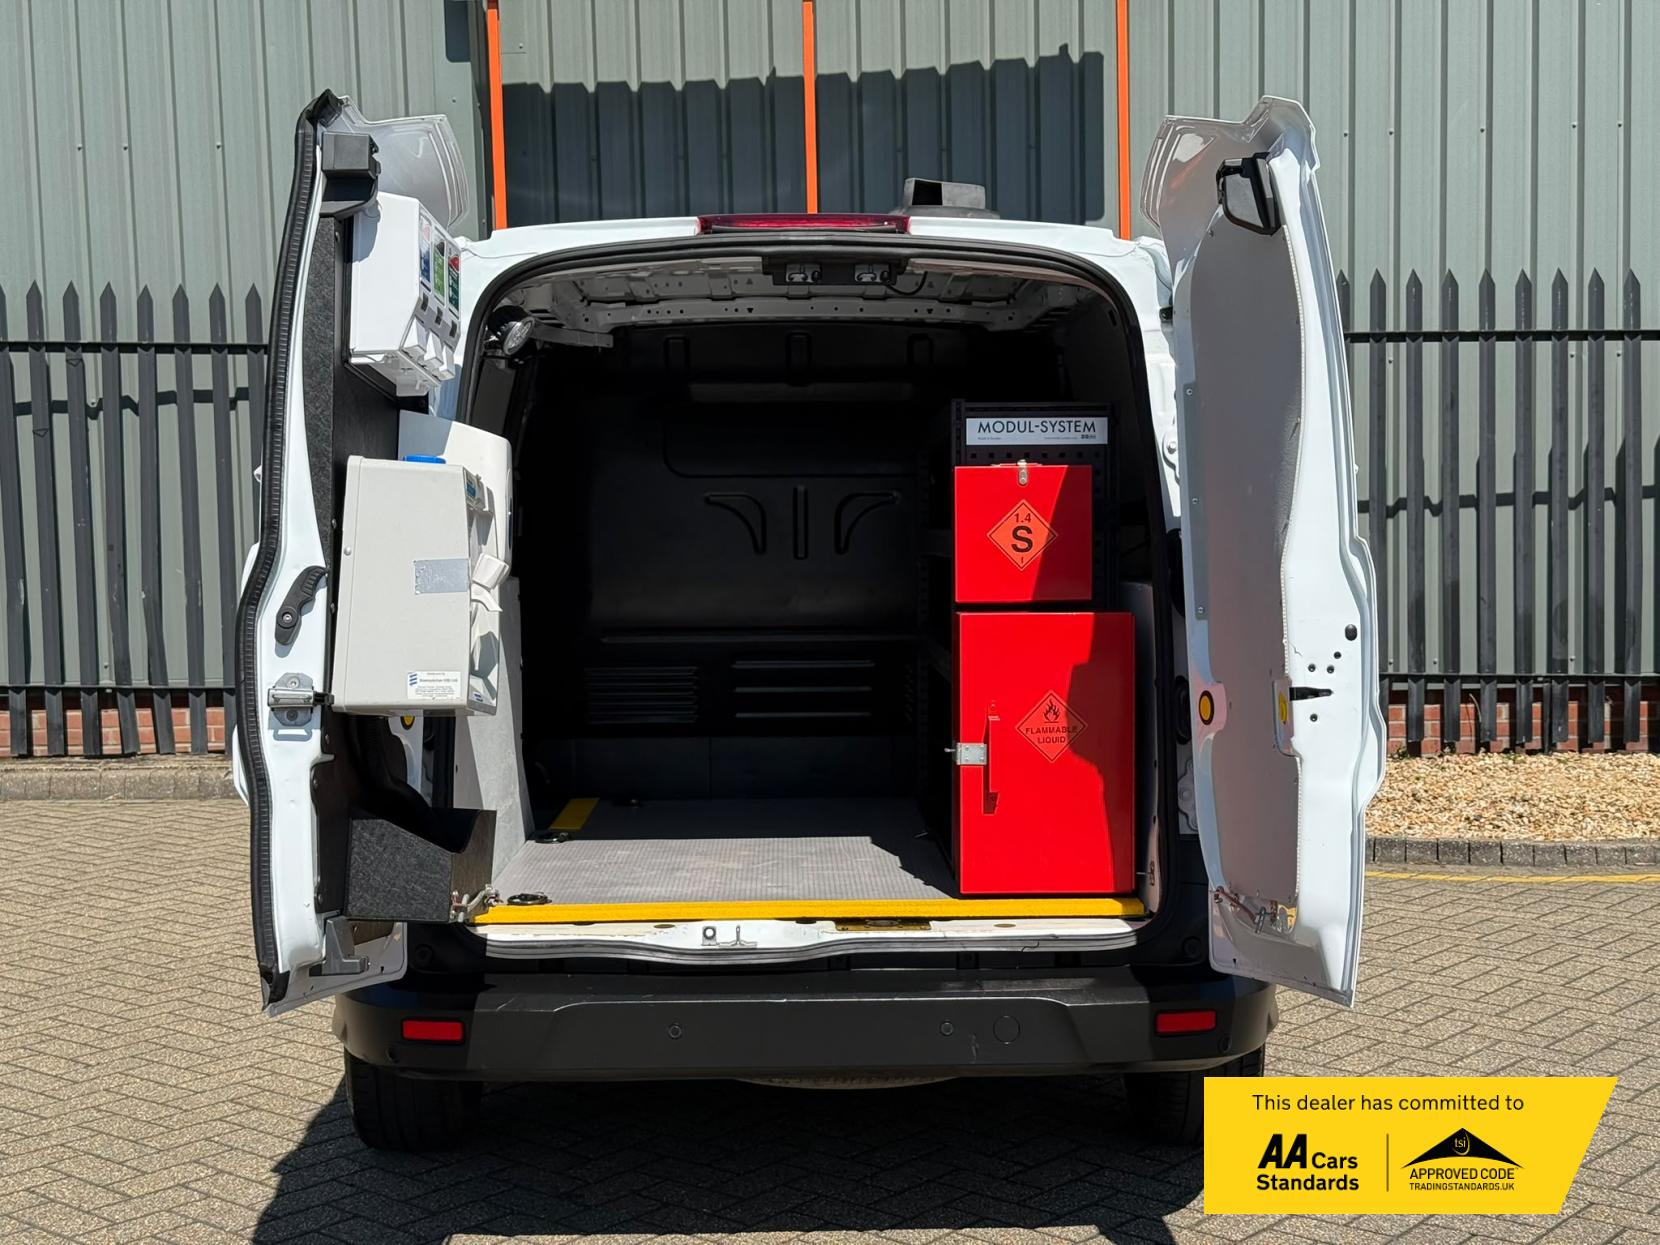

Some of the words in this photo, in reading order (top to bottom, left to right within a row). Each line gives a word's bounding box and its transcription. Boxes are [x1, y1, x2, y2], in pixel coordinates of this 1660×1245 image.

[977, 420, 1097, 434] MODUL-SYSTEM
[1014, 513, 1031, 523] 1.4
[1011, 525, 1033, 553] S
[1025, 726, 1078, 735] FLAMMABLE
[1037, 736, 1066, 744] LIQUID
